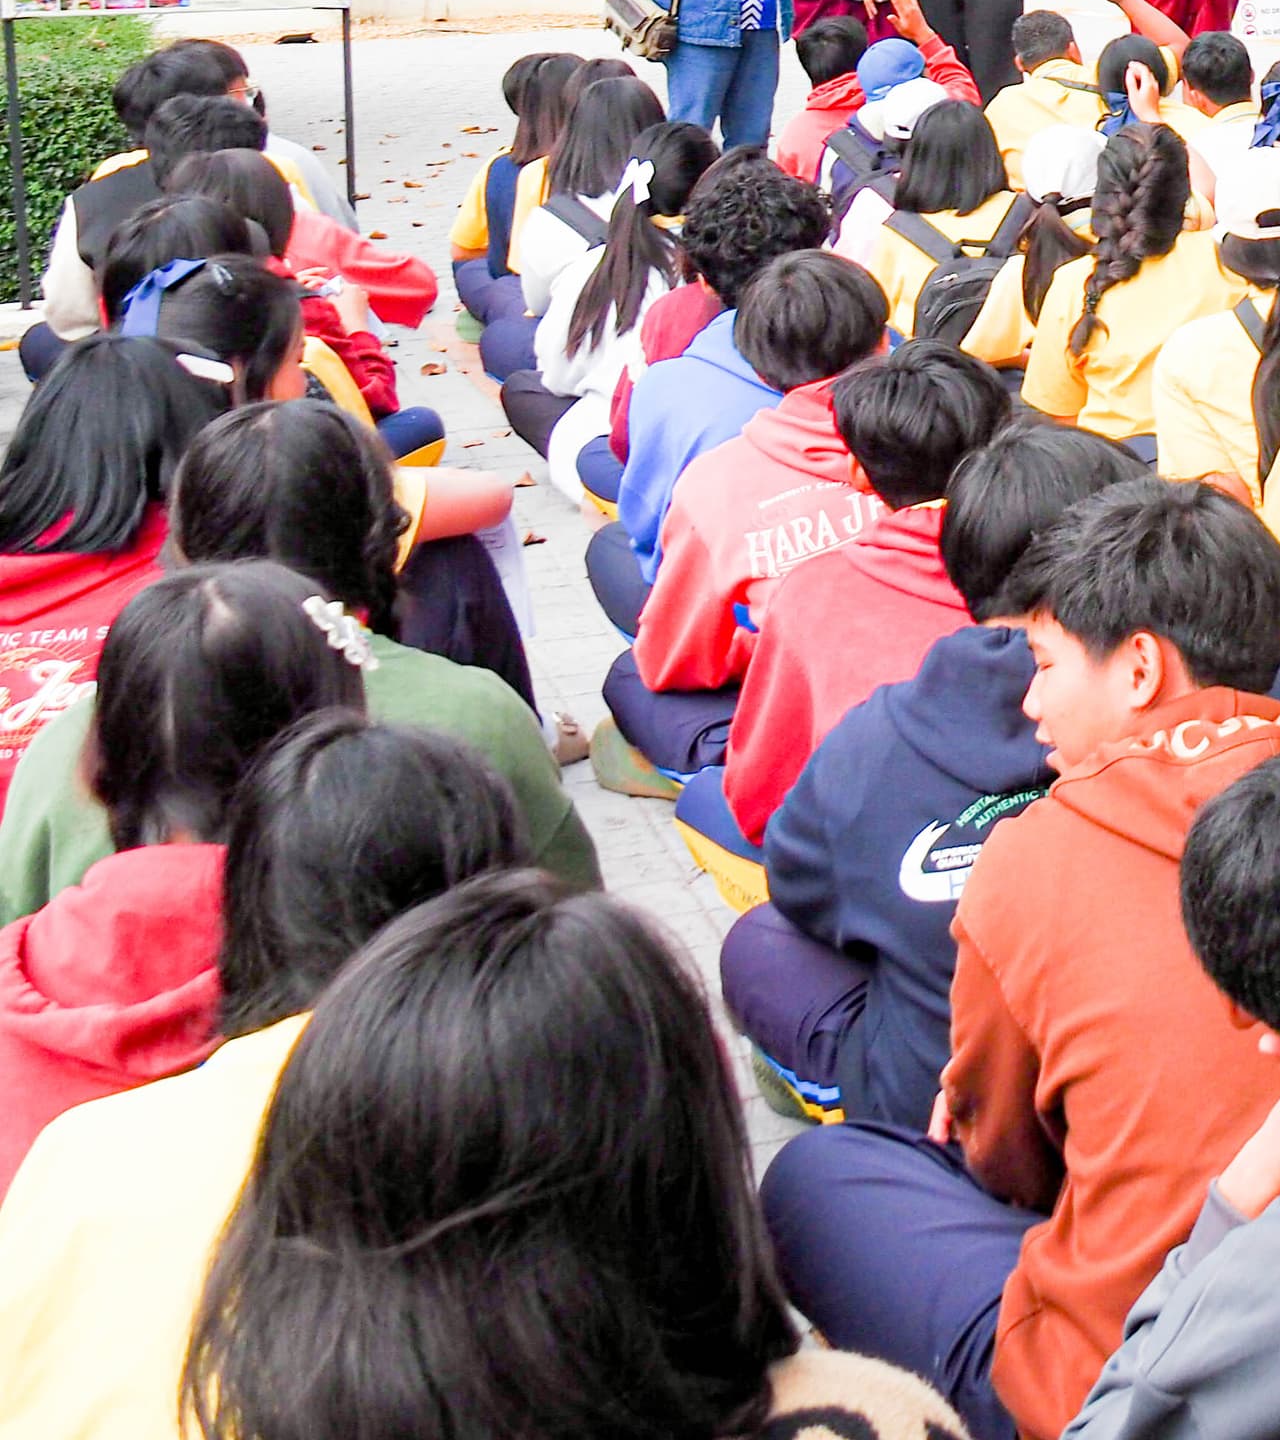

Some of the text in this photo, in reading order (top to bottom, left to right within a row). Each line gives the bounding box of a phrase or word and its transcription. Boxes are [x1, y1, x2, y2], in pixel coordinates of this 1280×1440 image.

[744, 509, 841, 578] HARA
[29, 626, 88, 644] TEAM
[974, 790, 1040, 829] AUTHENTIC
